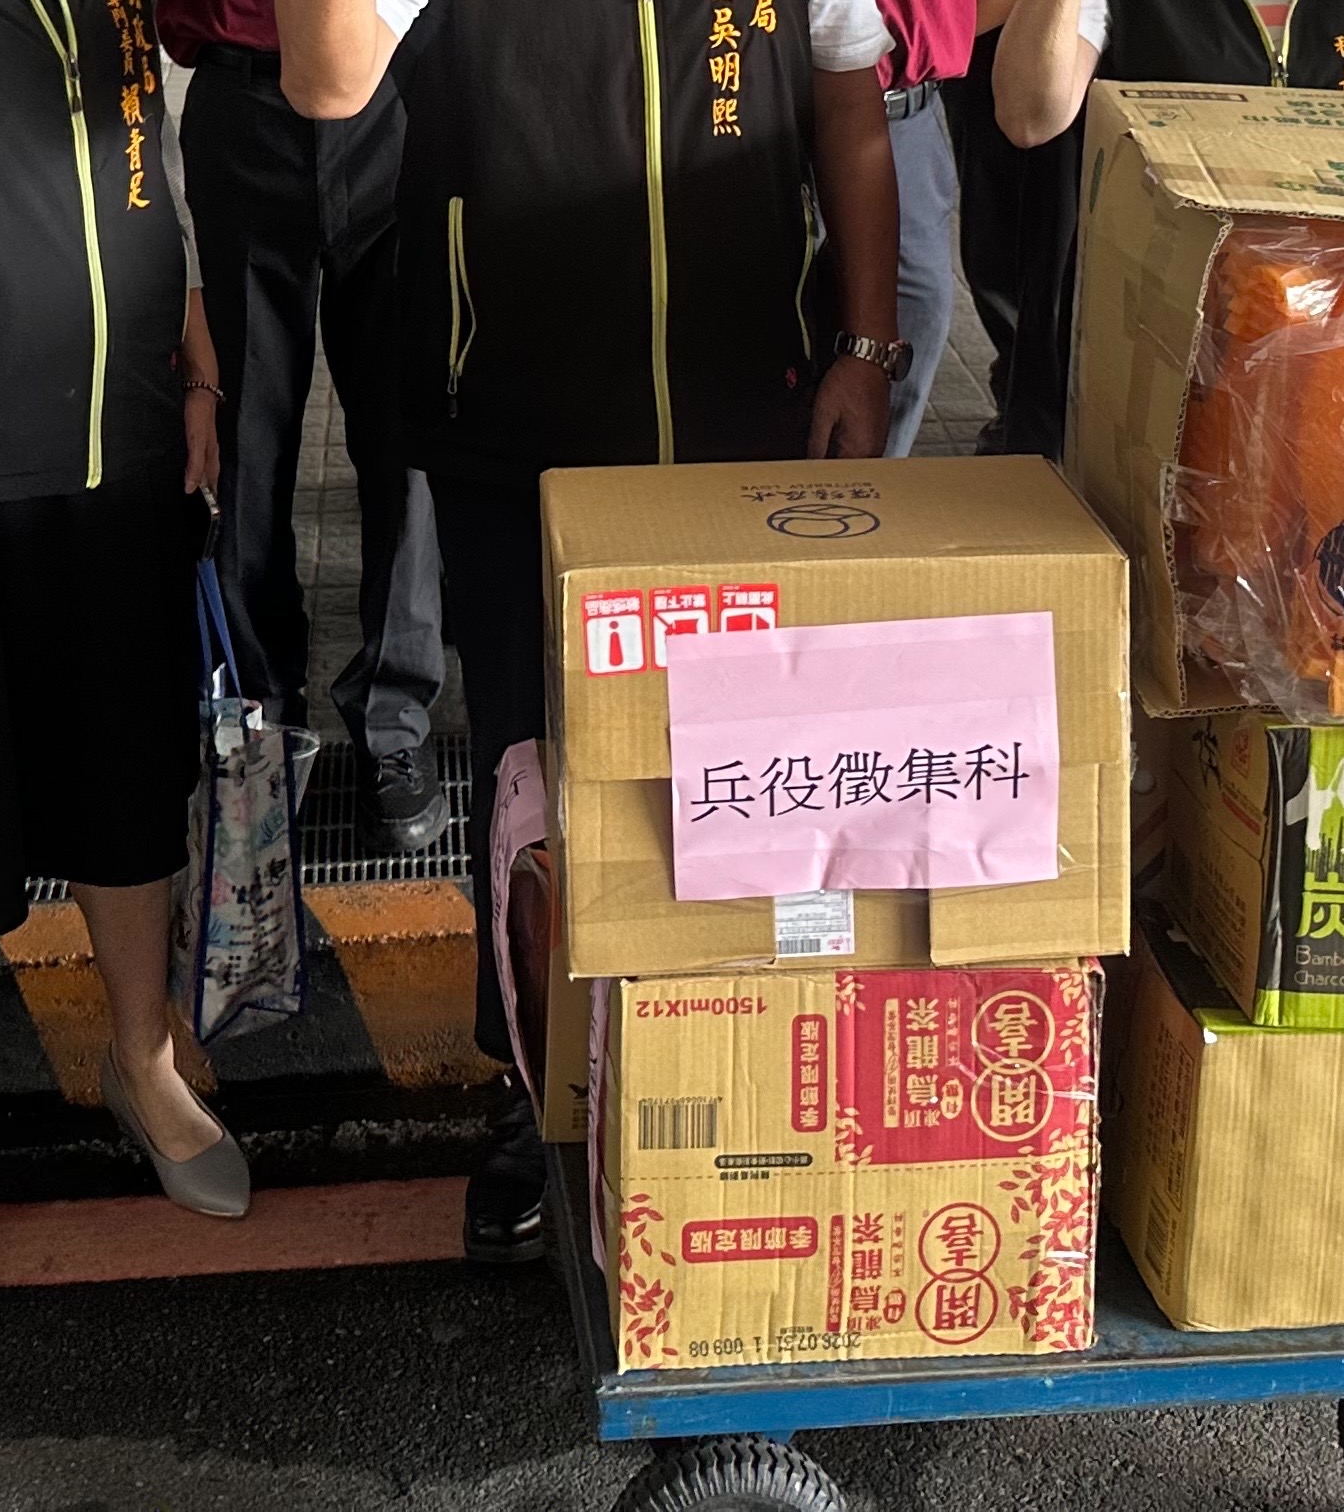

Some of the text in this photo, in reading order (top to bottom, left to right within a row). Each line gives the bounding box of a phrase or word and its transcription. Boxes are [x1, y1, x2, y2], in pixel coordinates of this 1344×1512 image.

[690, 742, 1030, 823] 兵役徵集科
[636, 997, 767, 1018] 1500mlX12
[906, 998, 939, 1106] 烏龍茶
[800, 1020, 820, 1128] 季節限定版
[989, 1001, 1038, 1126] 開喜
[903, 1109, 941, 1128] 凍頂
[689, 1225, 812, 1255] 季節限定版
[850, 1213, 884, 1314] 烏龍茶
[932, 1213, 984, 1331] 開喜
[753, 1336, 762, 1353] 1
